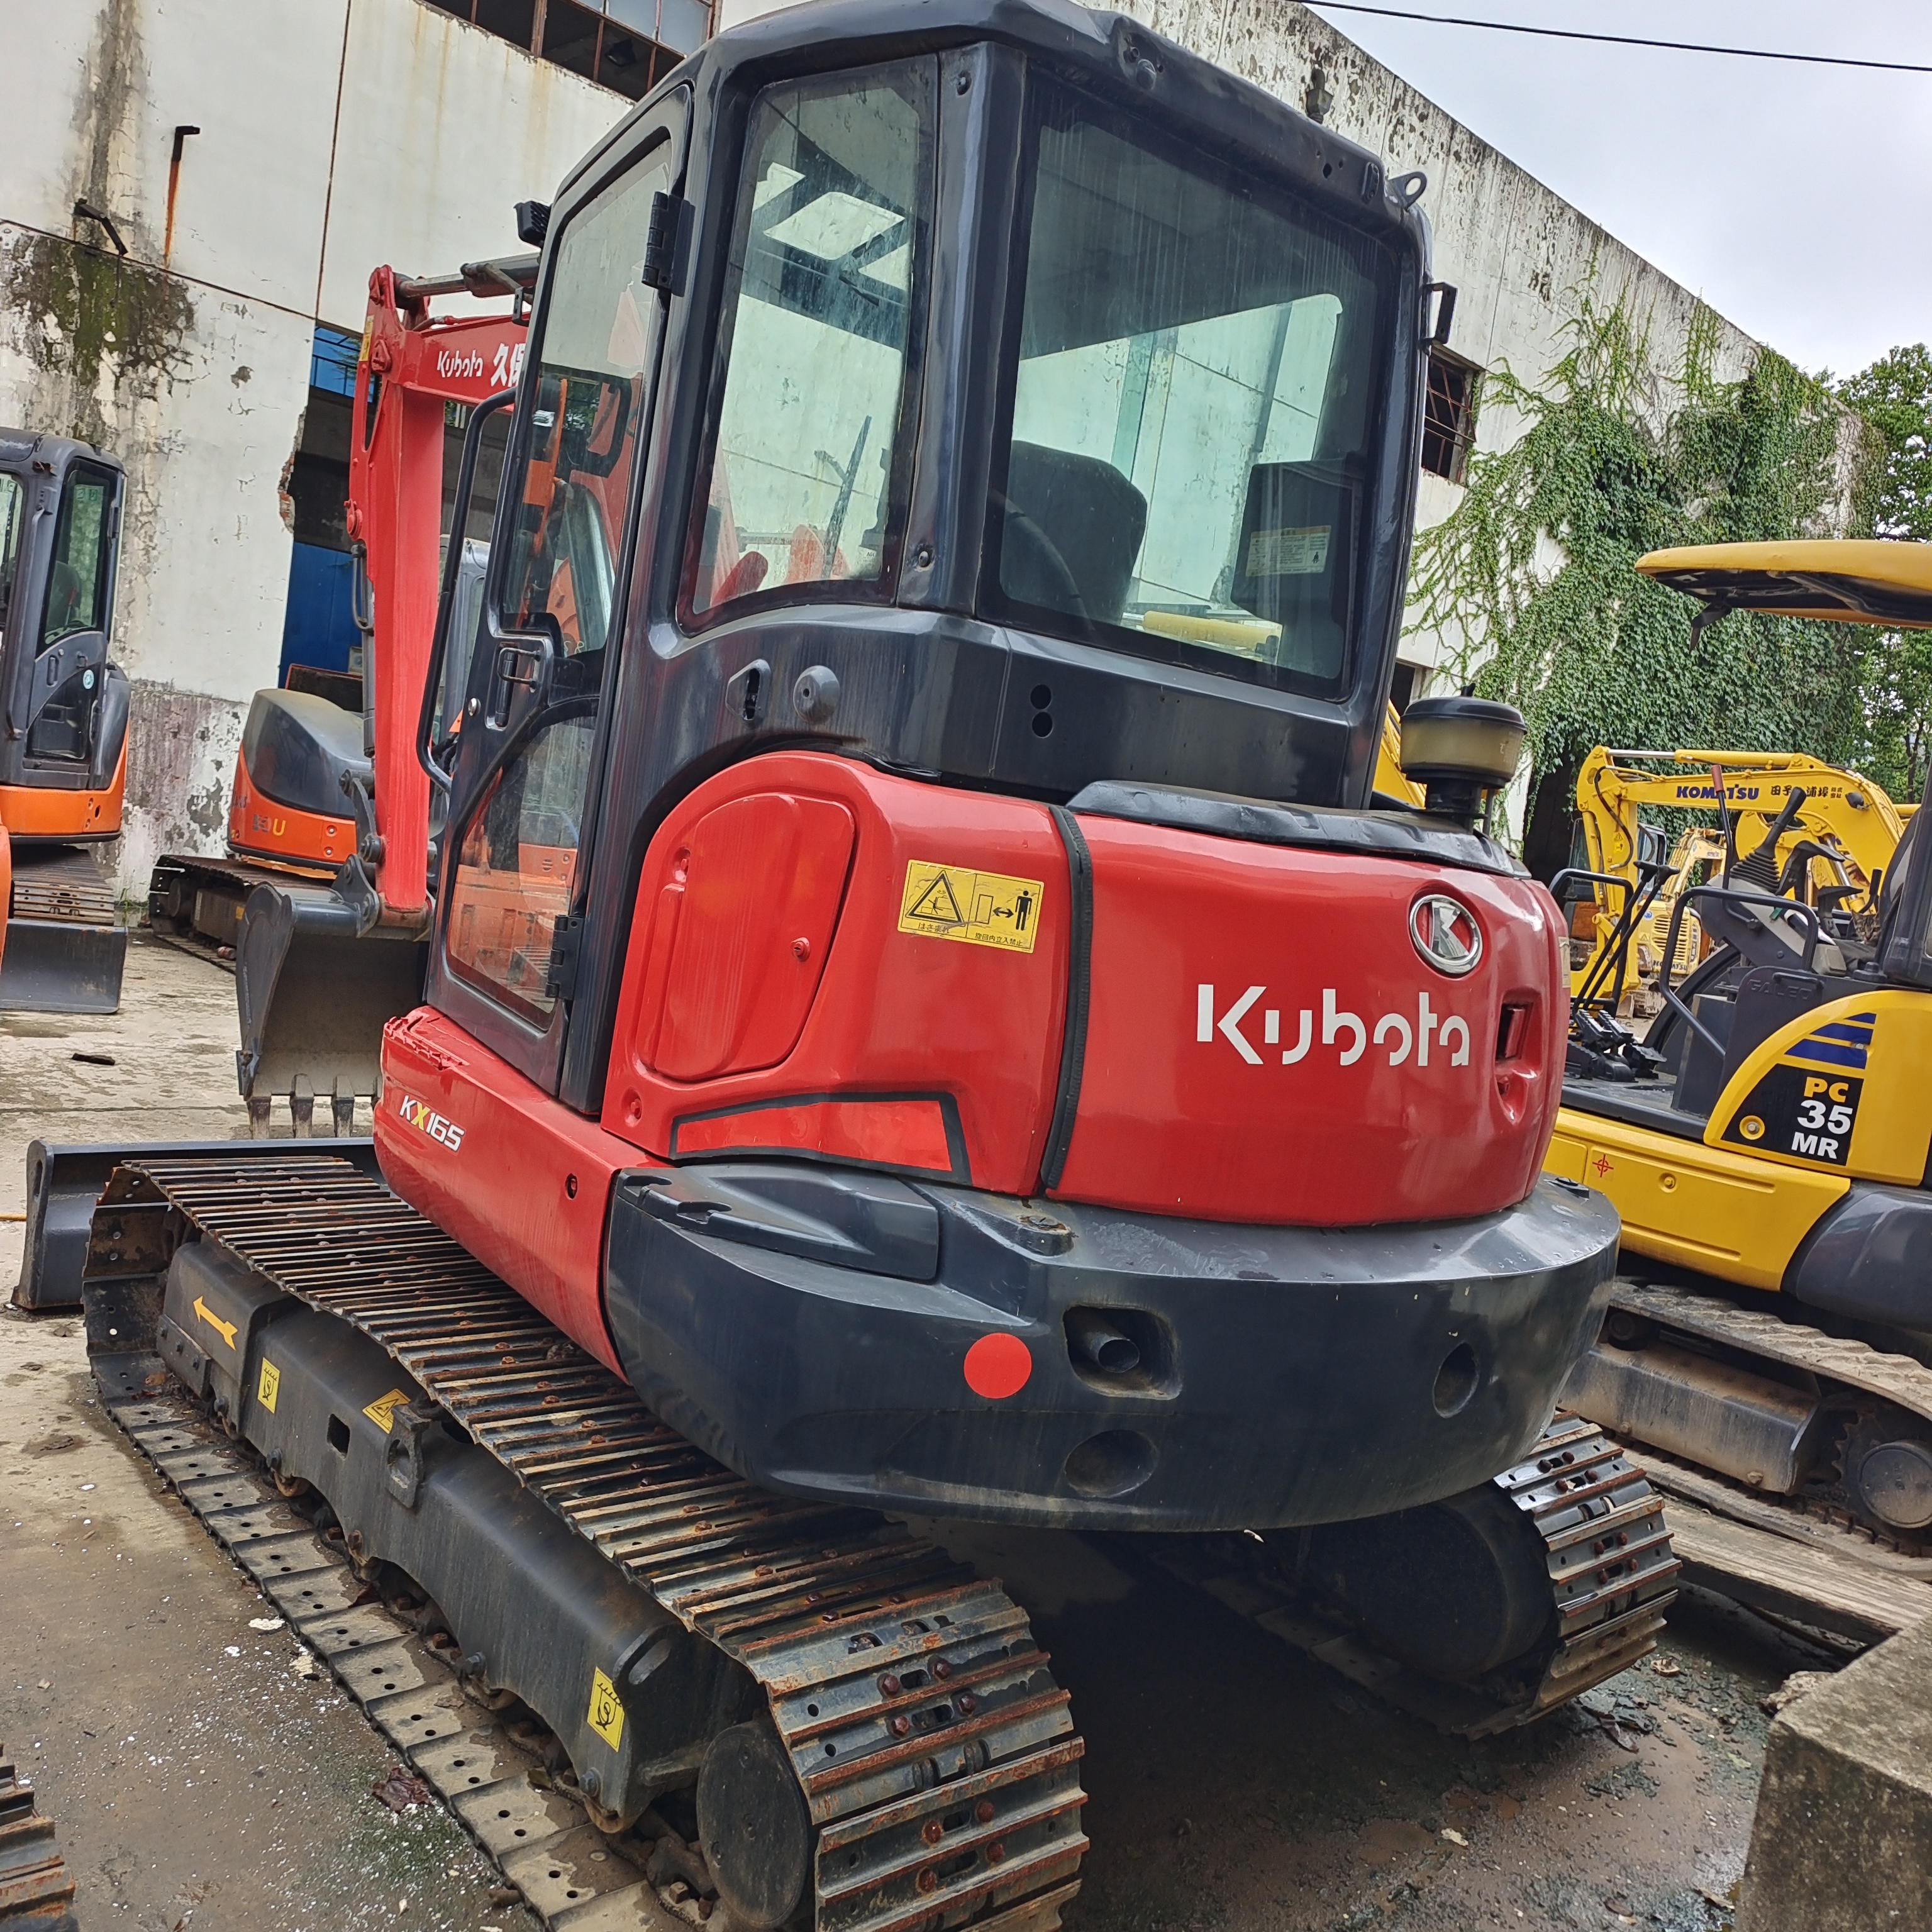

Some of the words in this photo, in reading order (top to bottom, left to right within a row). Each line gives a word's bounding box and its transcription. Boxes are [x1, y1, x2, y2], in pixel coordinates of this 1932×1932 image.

[436, 350, 483, 377] Kubota
[1677, 784, 1760, 800] KOMTSU
[1197, 984, 1470, 1067] Kubota
[1804, 1076, 1849, 1103] PC
[399, 1095, 465, 1152] KX165
[1797, 1099, 1853, 1135] 35
[1791, 1131, 1838, 1159] MR
